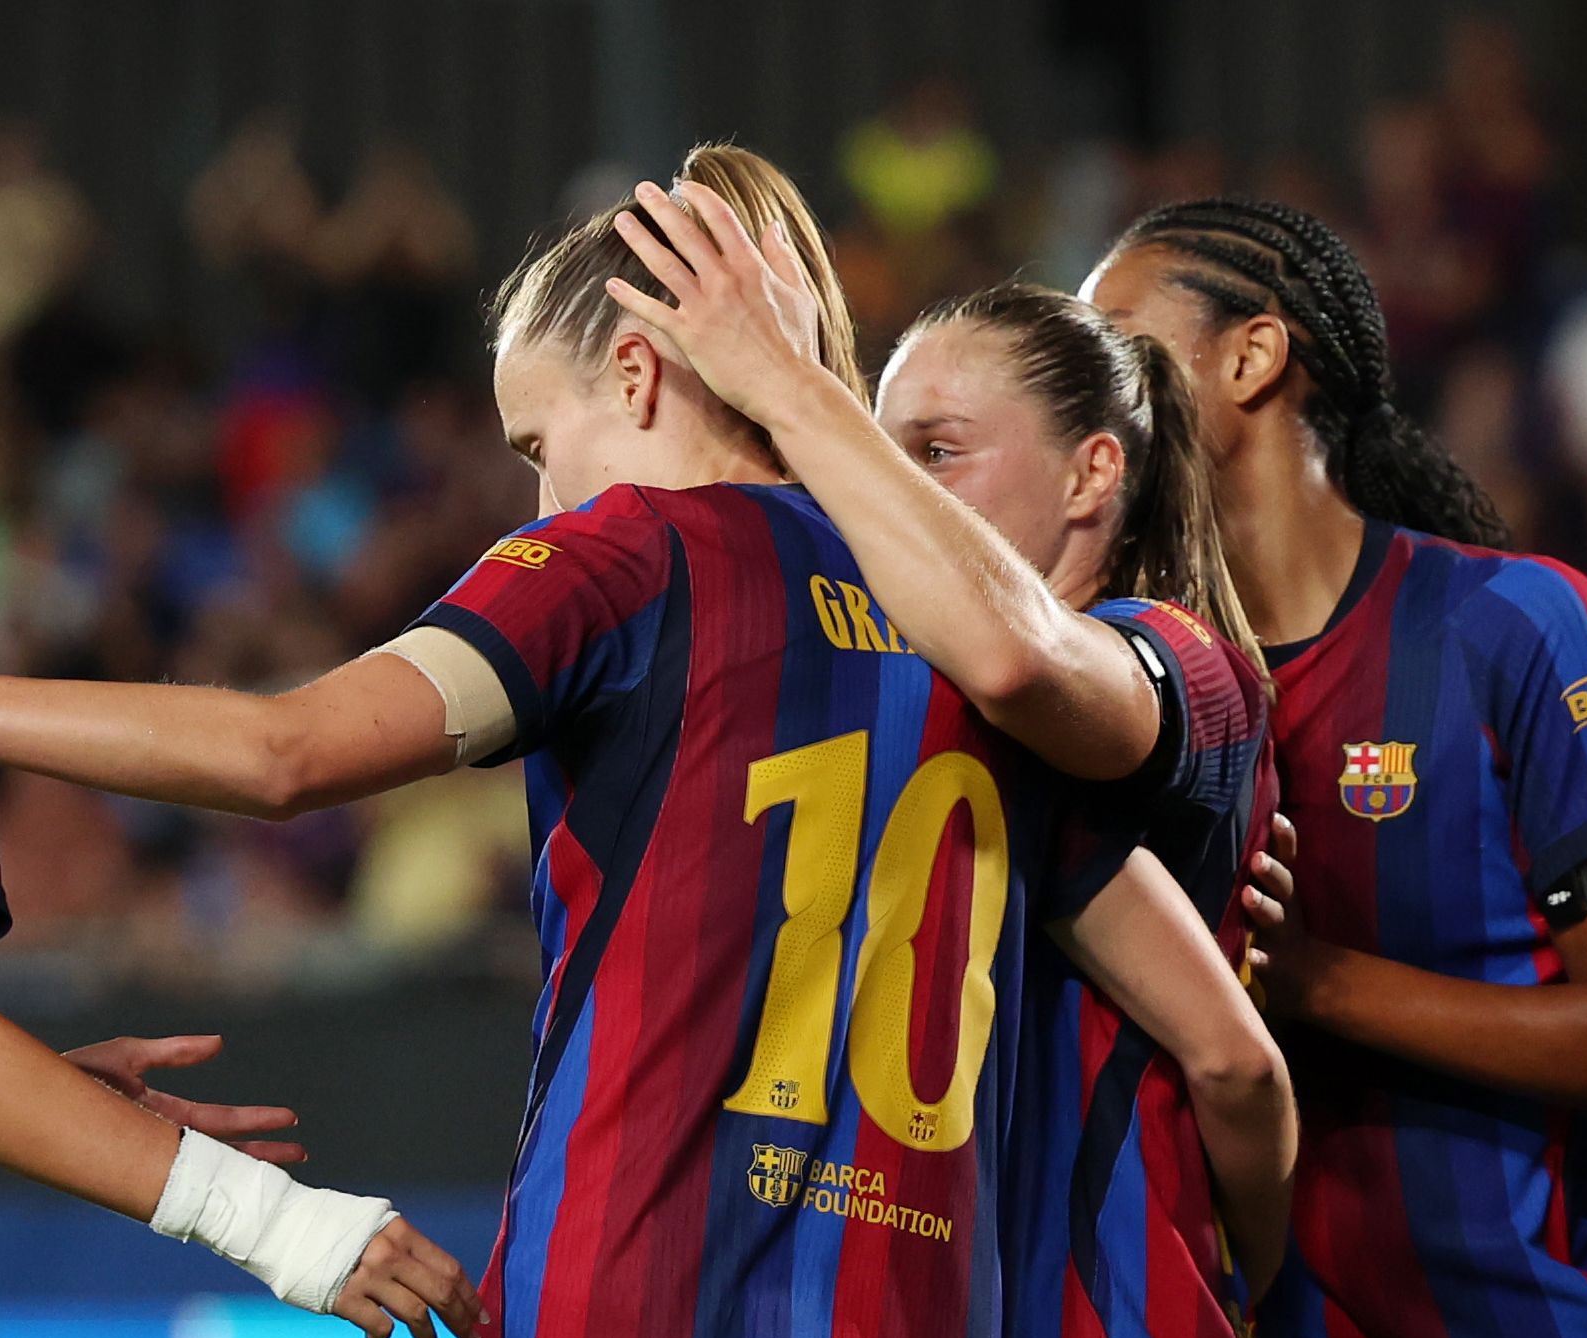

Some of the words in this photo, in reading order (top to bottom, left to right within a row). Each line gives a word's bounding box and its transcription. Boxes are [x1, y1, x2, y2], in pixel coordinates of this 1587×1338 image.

[723, 729, 1010, 1152] 10
[809, 1159, 886, 1197] BARÇA
[802, 1186, 953, 1243] FOUNDATION
